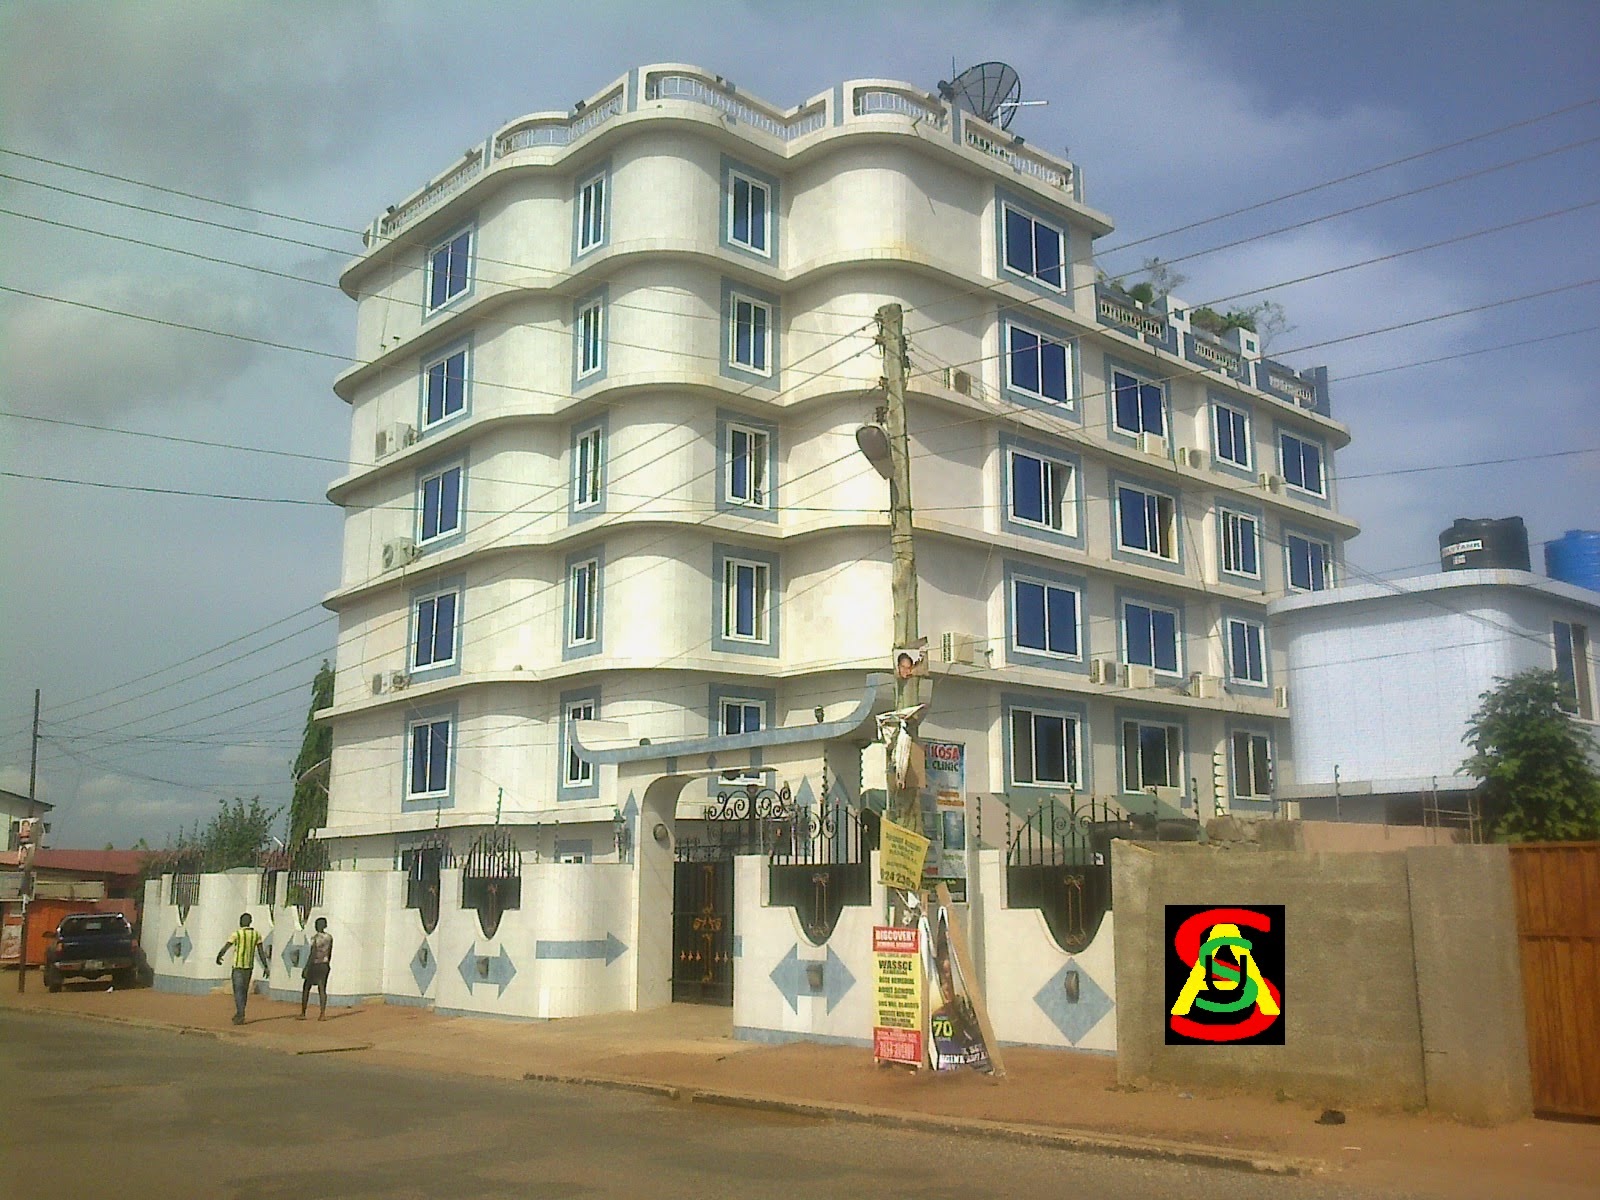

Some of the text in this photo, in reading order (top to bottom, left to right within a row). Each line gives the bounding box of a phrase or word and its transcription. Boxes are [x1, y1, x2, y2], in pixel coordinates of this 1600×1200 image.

[931, 760, 959, 772] CLINIC
[878, 960, 913, 971] WASSCE
[933, 1020, 953, 1037] 70
